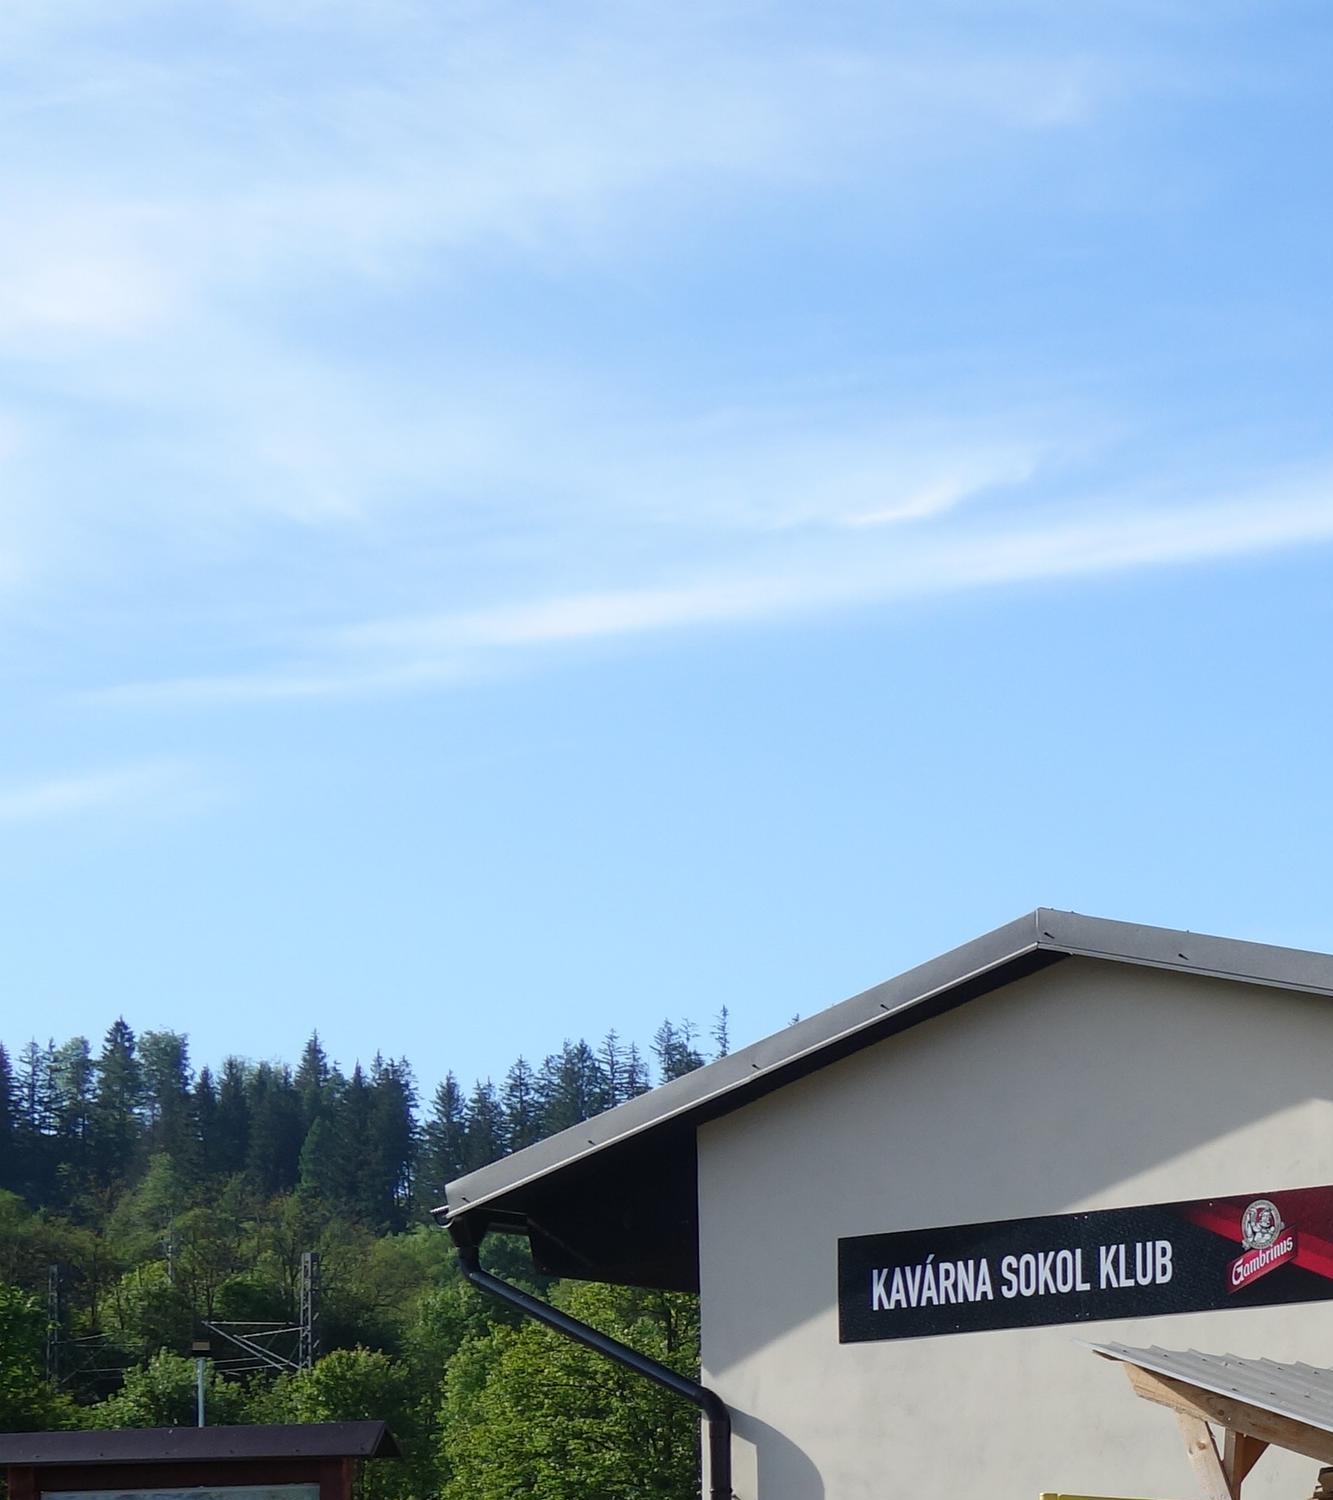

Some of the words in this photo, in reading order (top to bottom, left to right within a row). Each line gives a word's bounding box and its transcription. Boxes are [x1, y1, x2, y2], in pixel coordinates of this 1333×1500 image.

[872, 1253, 994, 1311] KAVÁRNA
[1000, 1248, 1090, 1299] SOKOL
[1100, 1240, 1174, 1290] KLUB
[1231, 1237, 1294, 1286] Gambrinus
